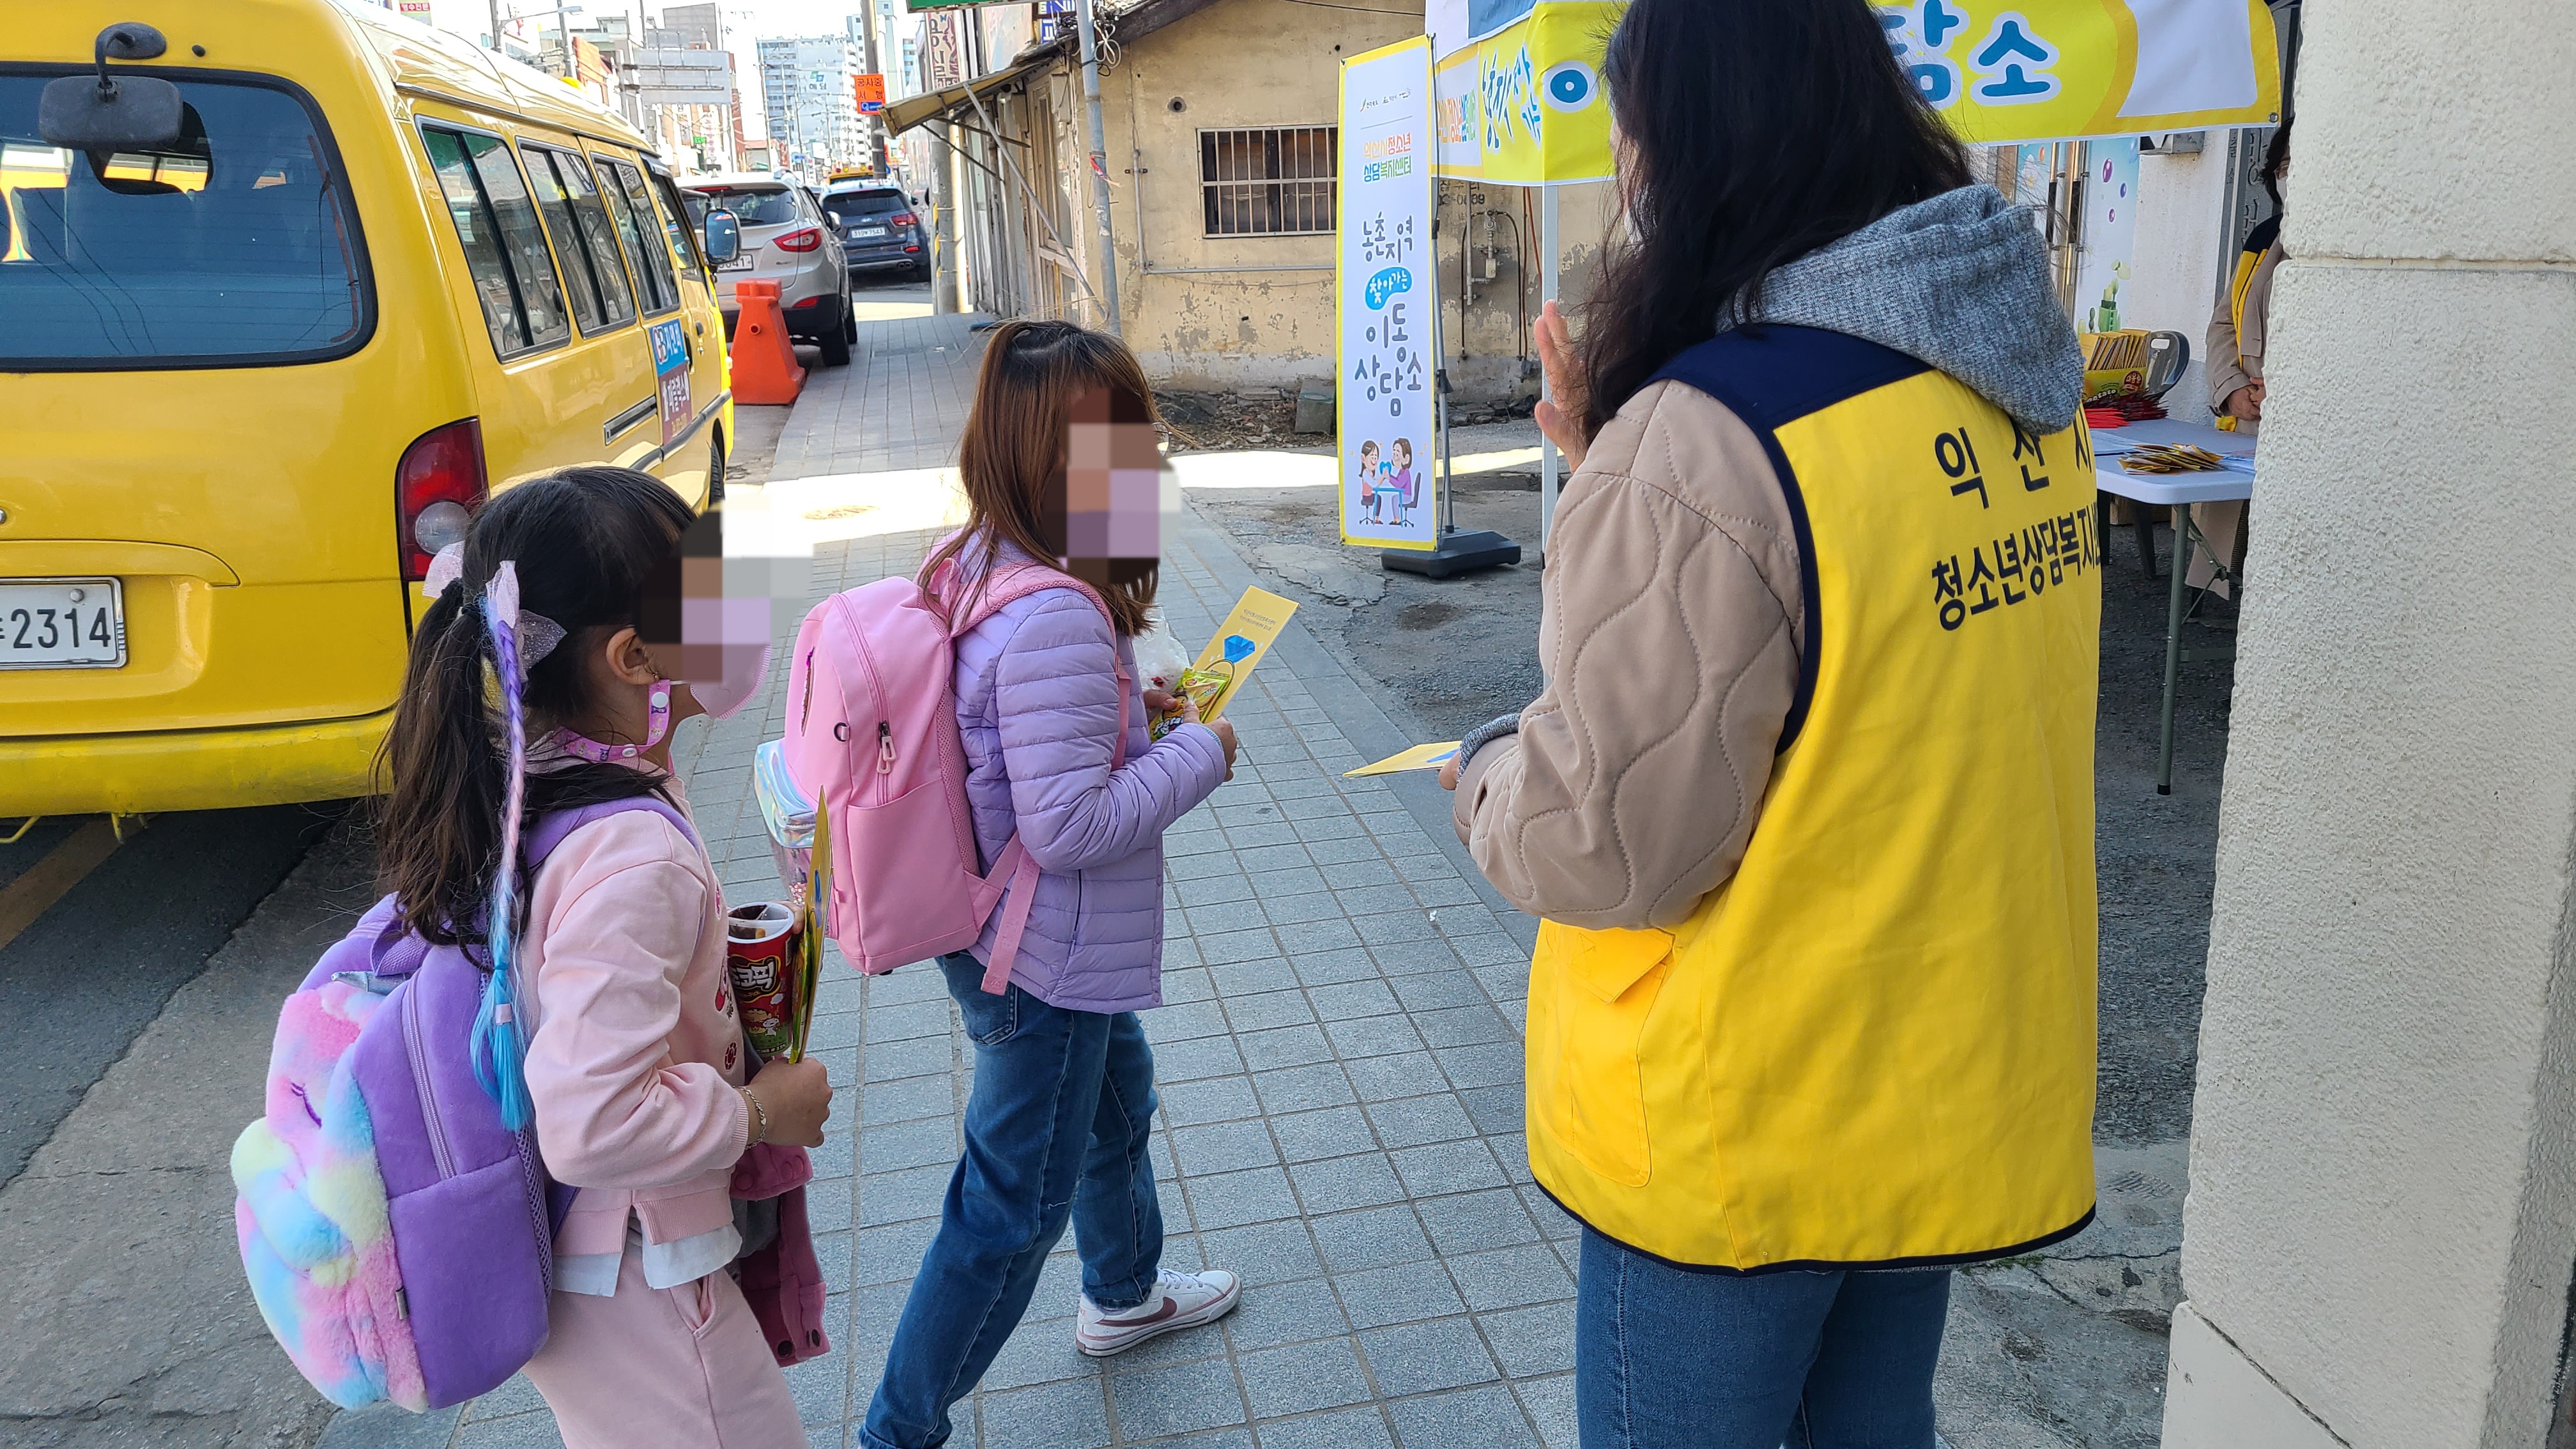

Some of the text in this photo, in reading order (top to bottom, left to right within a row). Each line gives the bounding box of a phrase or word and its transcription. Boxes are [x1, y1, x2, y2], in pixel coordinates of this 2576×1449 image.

[1881, 0, 2051, 101] 담소
[857, 78, 882, 87] 공사중
[1362, 211, 1412, 263] 농촌지역
[1369, 270, 1408, 304] 찾아가는
[1366, 303, 1409, 363] 이동
[1354, 351, 1422, 417] 상담소
